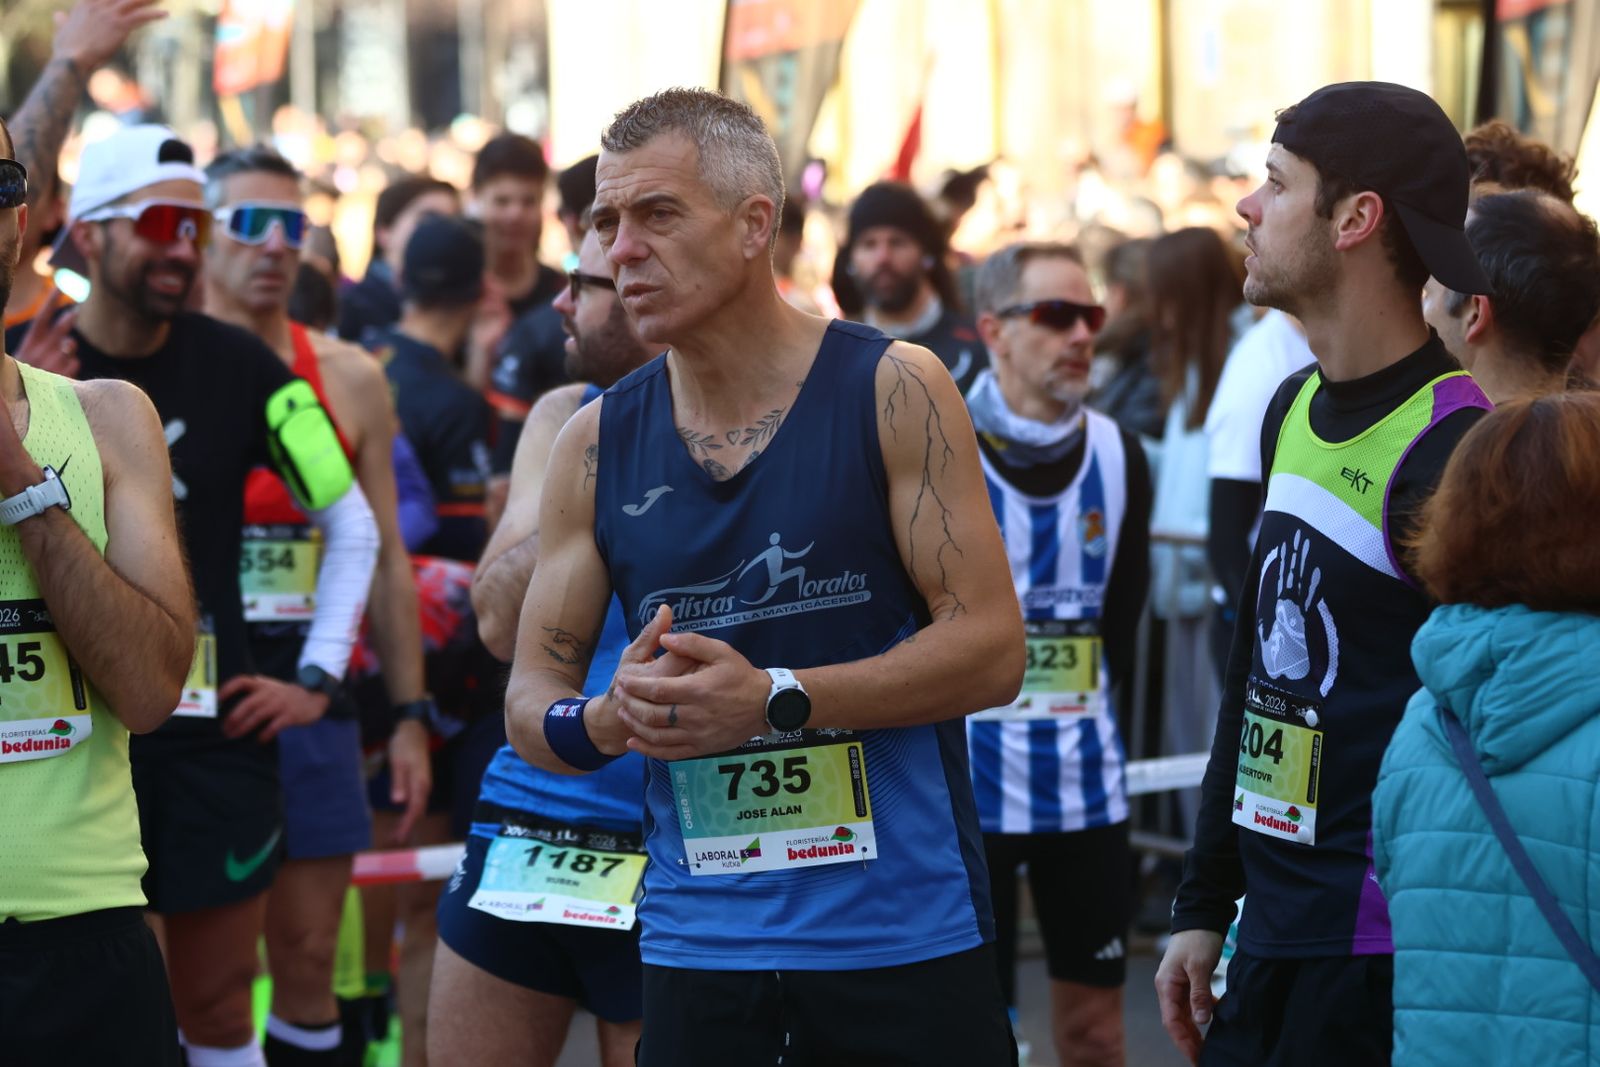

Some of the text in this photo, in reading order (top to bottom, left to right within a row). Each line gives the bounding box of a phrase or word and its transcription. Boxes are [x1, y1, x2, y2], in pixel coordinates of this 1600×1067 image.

[1341, 466, 1374, 495] EKT
[763, 604, 799, 617] MATA
[1264, 694, 1287, 711] 2026
[2, 735, 71, 754] bedunia
[718, 755, 812, 801] 735
[736, 804, 802, 820] JOSE ALAN
[1254, 811, 1299, 834] bedunia
[523, 845, 625, 877] 1187
[695, 847, 740, 862] LABORAL
[787, 842, 855, 861] bedunia
[562, 909, 617, 924] bedunia
